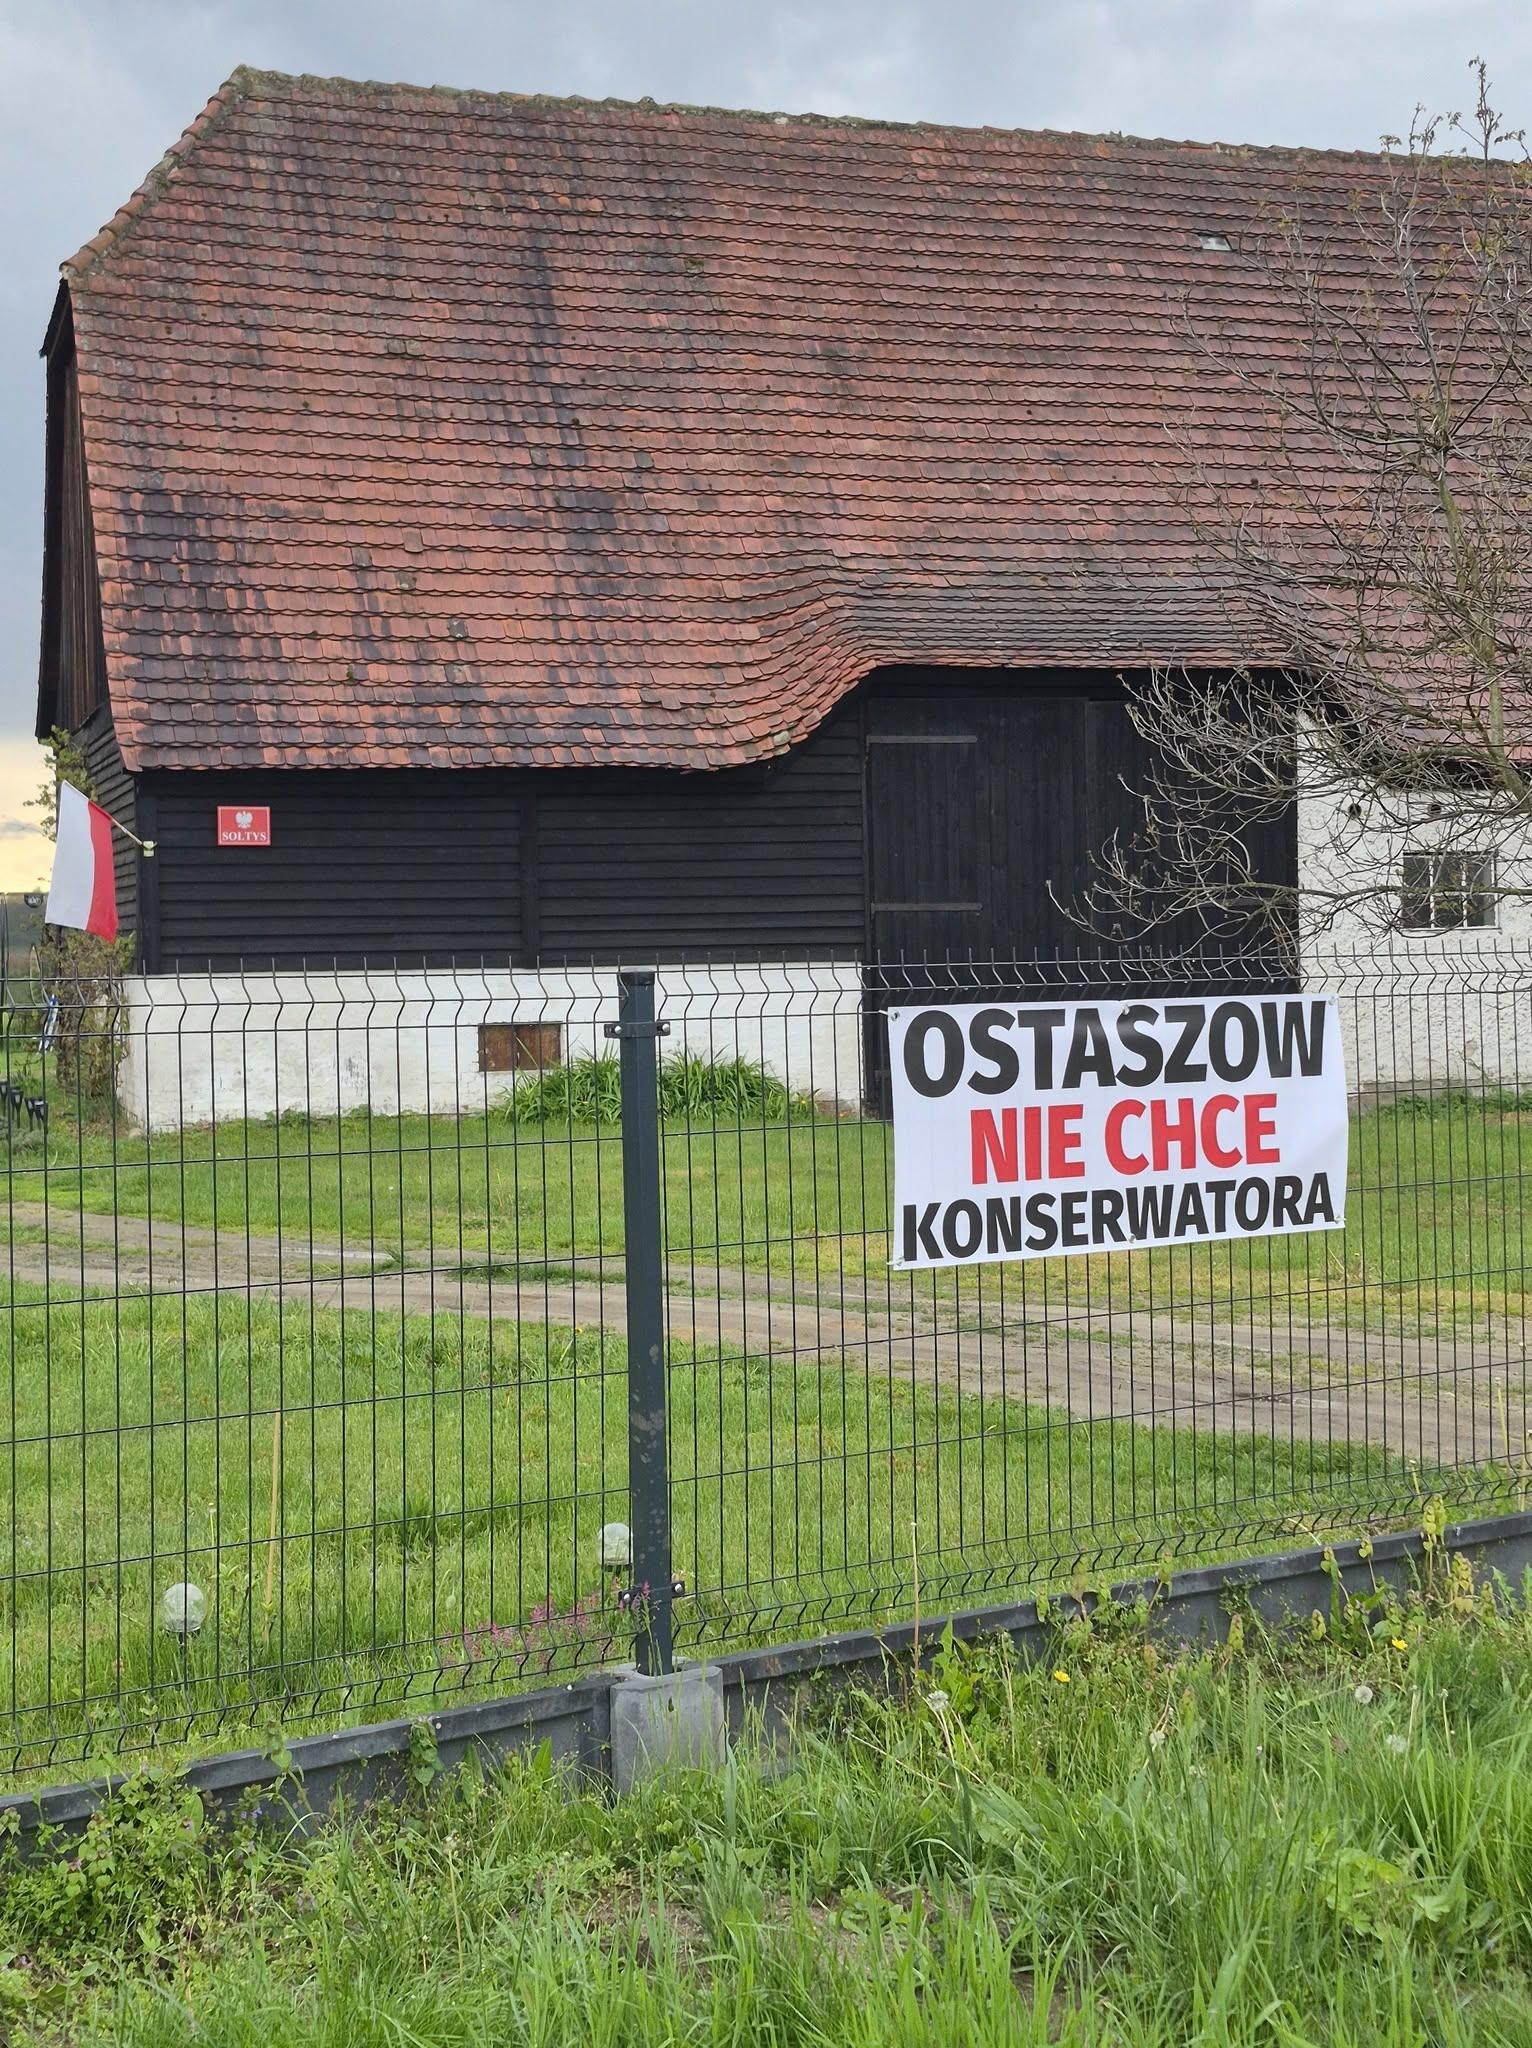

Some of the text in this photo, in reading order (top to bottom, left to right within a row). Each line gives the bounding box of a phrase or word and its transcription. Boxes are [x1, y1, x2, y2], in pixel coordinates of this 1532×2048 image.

[903, 1000, 1326, 1098] OSTASZOW
[970, 1093, 1281, 1185] NIE CHCE
[902, 1171, 1335, 1262] KONSERWATORA
